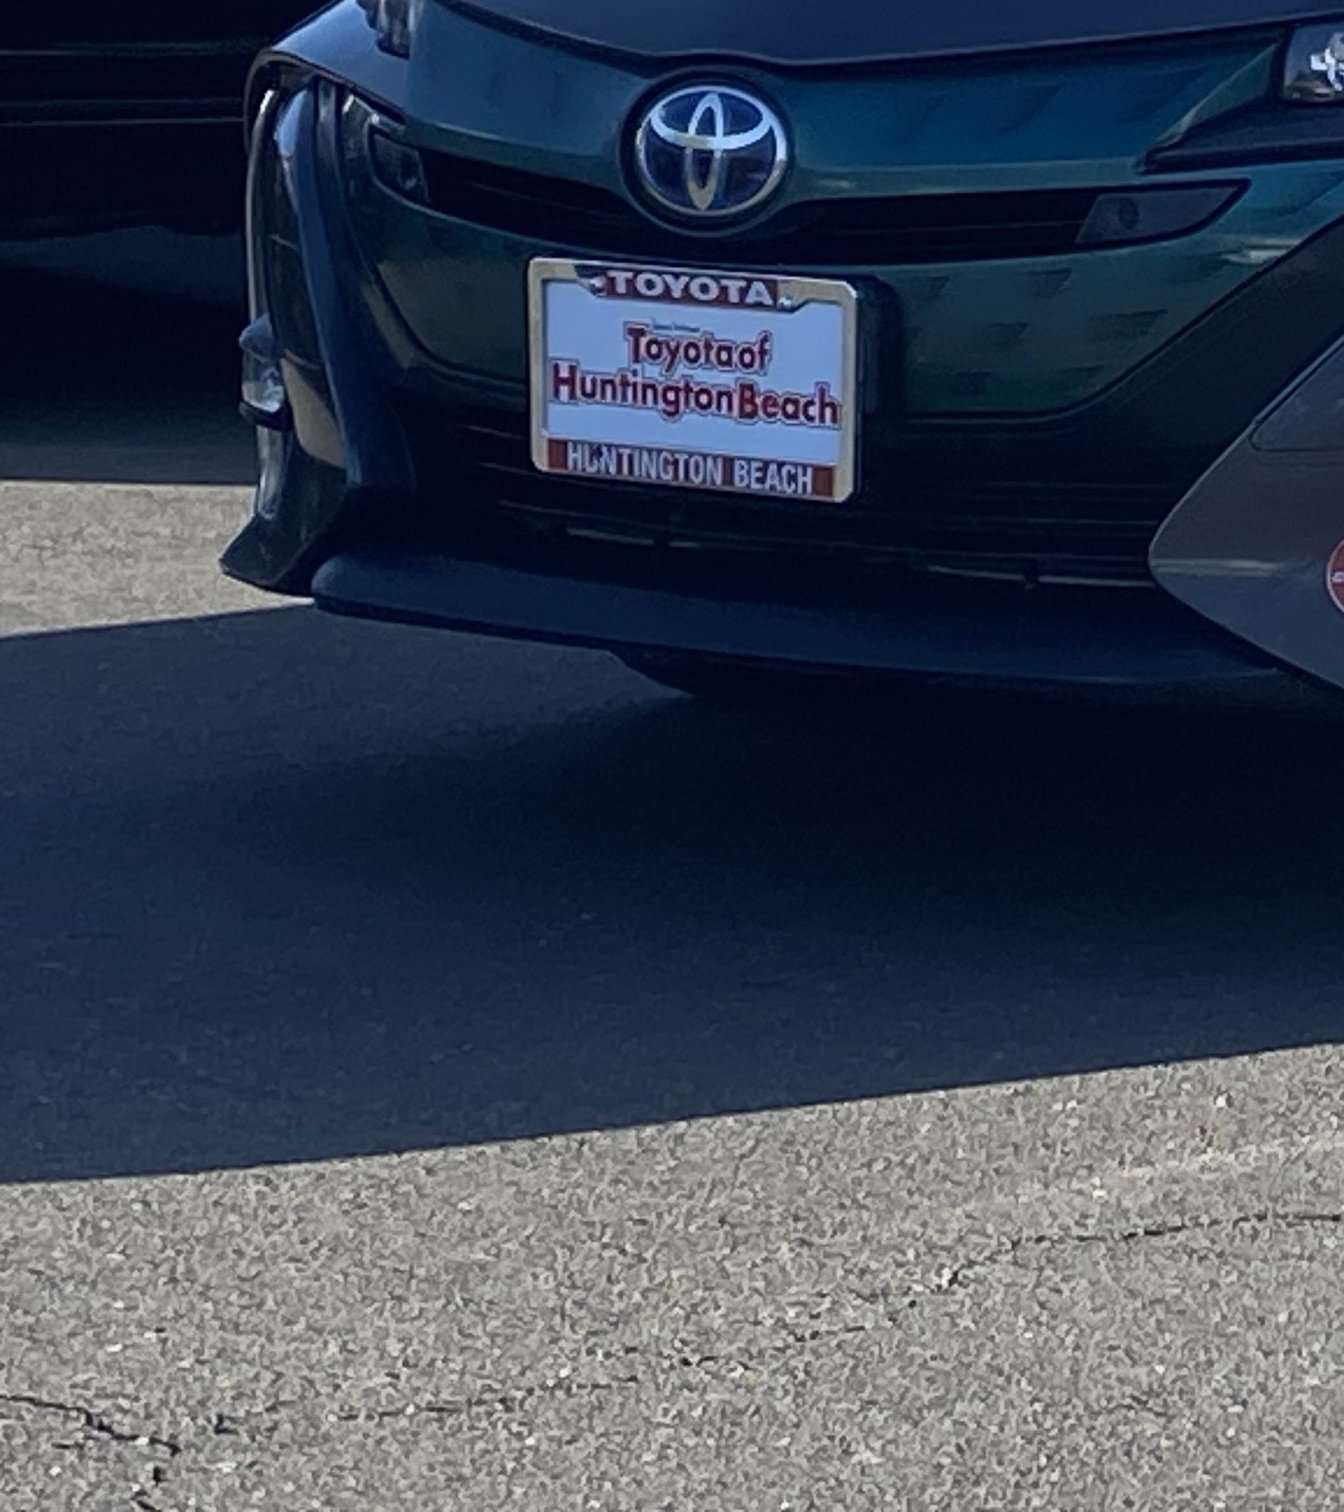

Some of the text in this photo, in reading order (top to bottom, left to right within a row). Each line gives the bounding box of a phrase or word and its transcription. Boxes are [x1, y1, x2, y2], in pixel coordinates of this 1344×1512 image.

[607, 271, 773, 306] TOYOTA
[625, 322, 773, 376] Toyota of
[550, 357, 841, 428] Huntington Beach
[566, 441, 813, 495] HUNTINGTON BEACH
